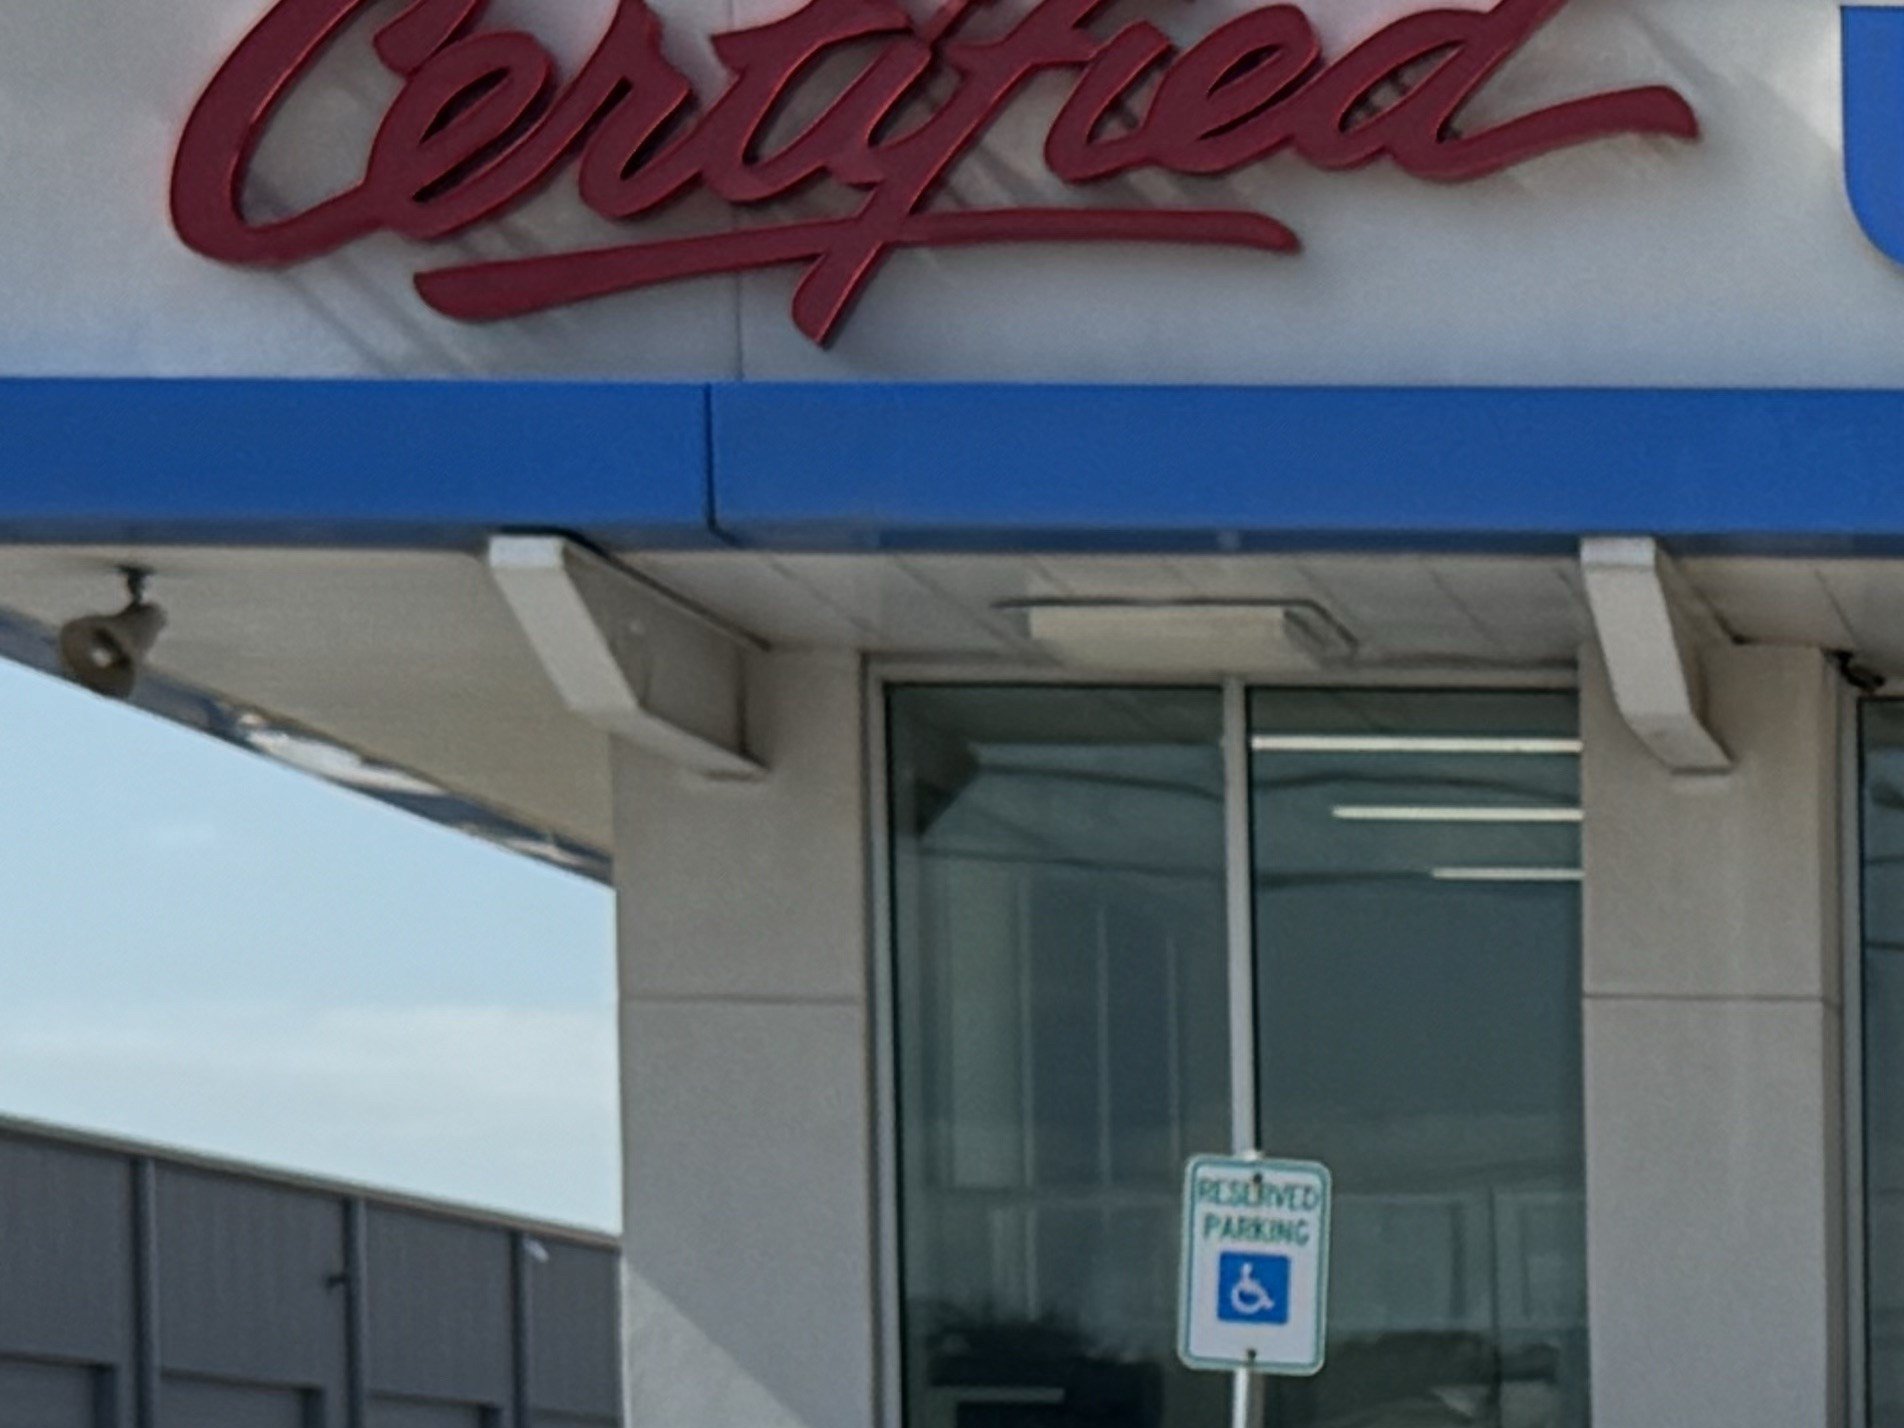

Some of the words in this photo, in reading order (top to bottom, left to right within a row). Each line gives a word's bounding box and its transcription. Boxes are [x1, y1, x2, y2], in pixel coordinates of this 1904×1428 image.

[169, 0, 1699, 346] Certified
[1198, 1179, 1319, 1212] RESERVED
[1203, 1212, 1311, 1246] PARKING
